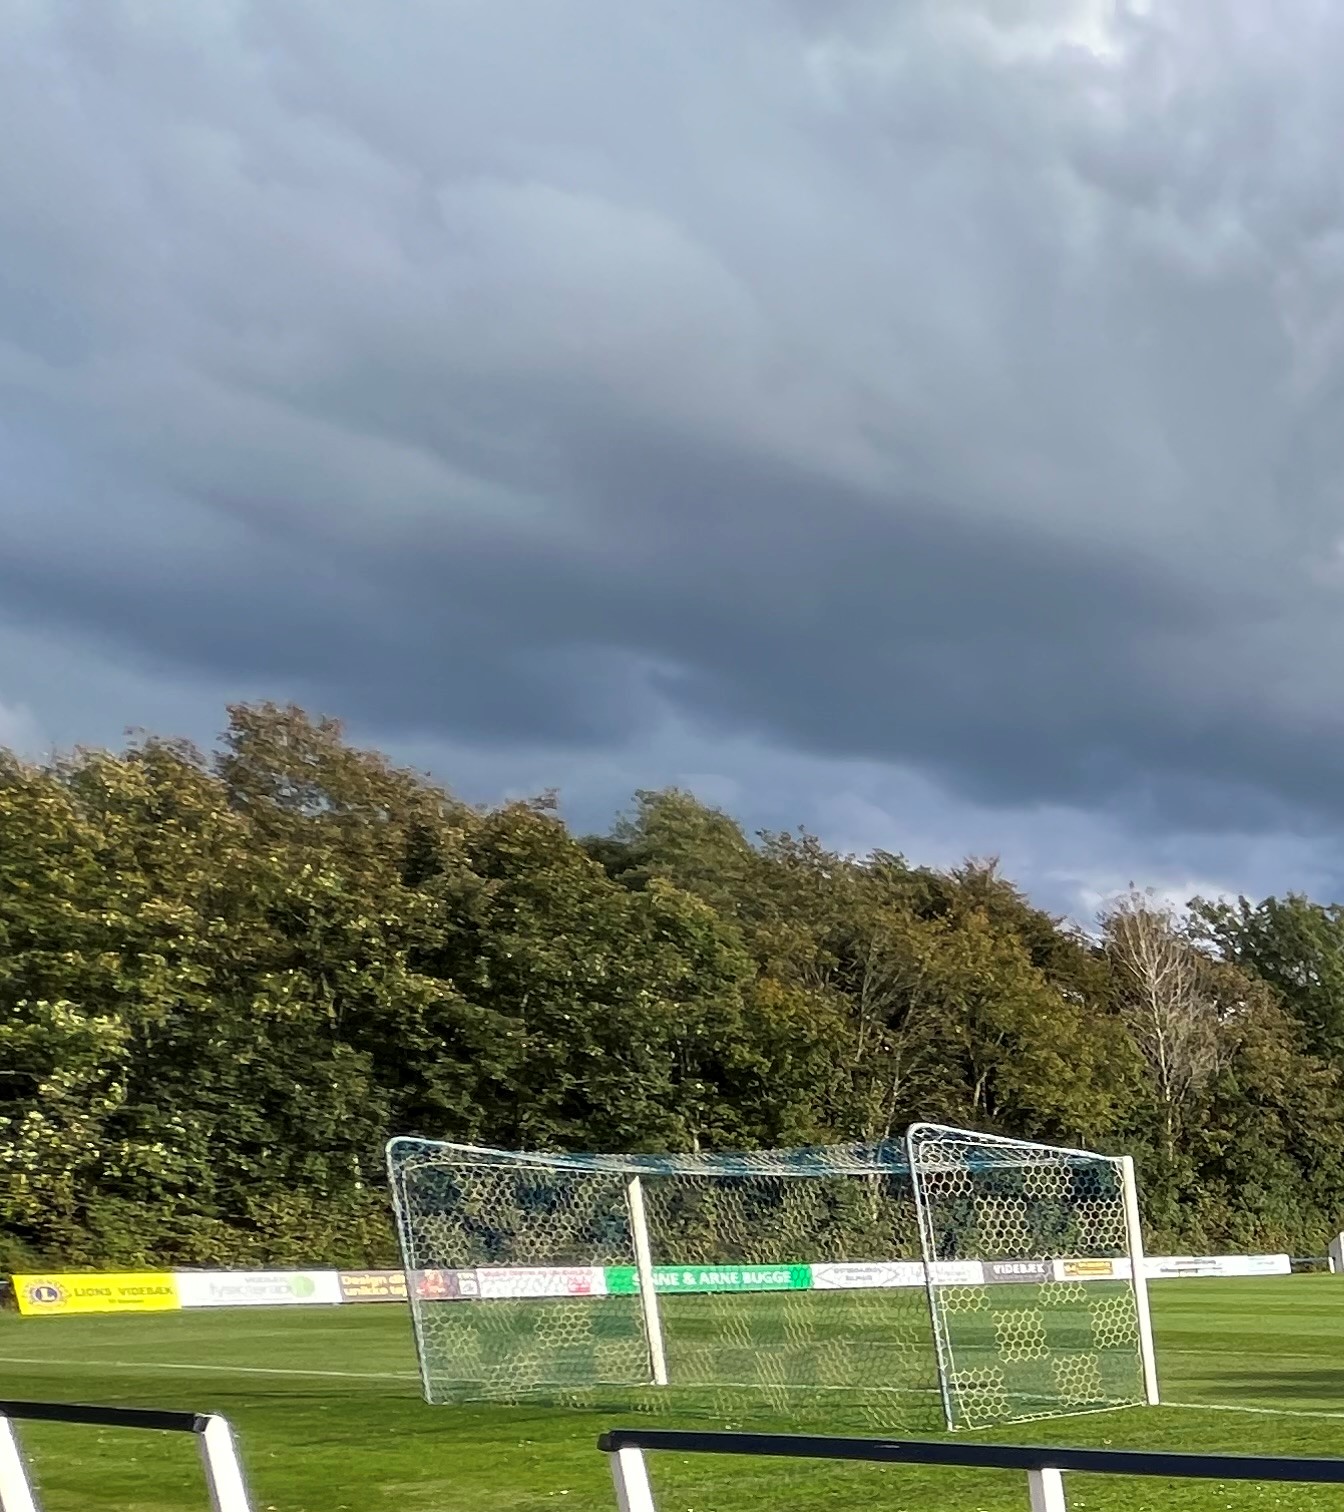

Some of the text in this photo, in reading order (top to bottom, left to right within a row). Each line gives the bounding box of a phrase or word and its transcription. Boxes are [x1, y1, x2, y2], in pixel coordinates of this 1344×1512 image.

[682, 1271, 697, 1286] &
[700, 1271, 739, 1285] ARNE
[741, 1270, 792, 1284] BUGGE
[74, 1287, 112, 1297] LIONS
